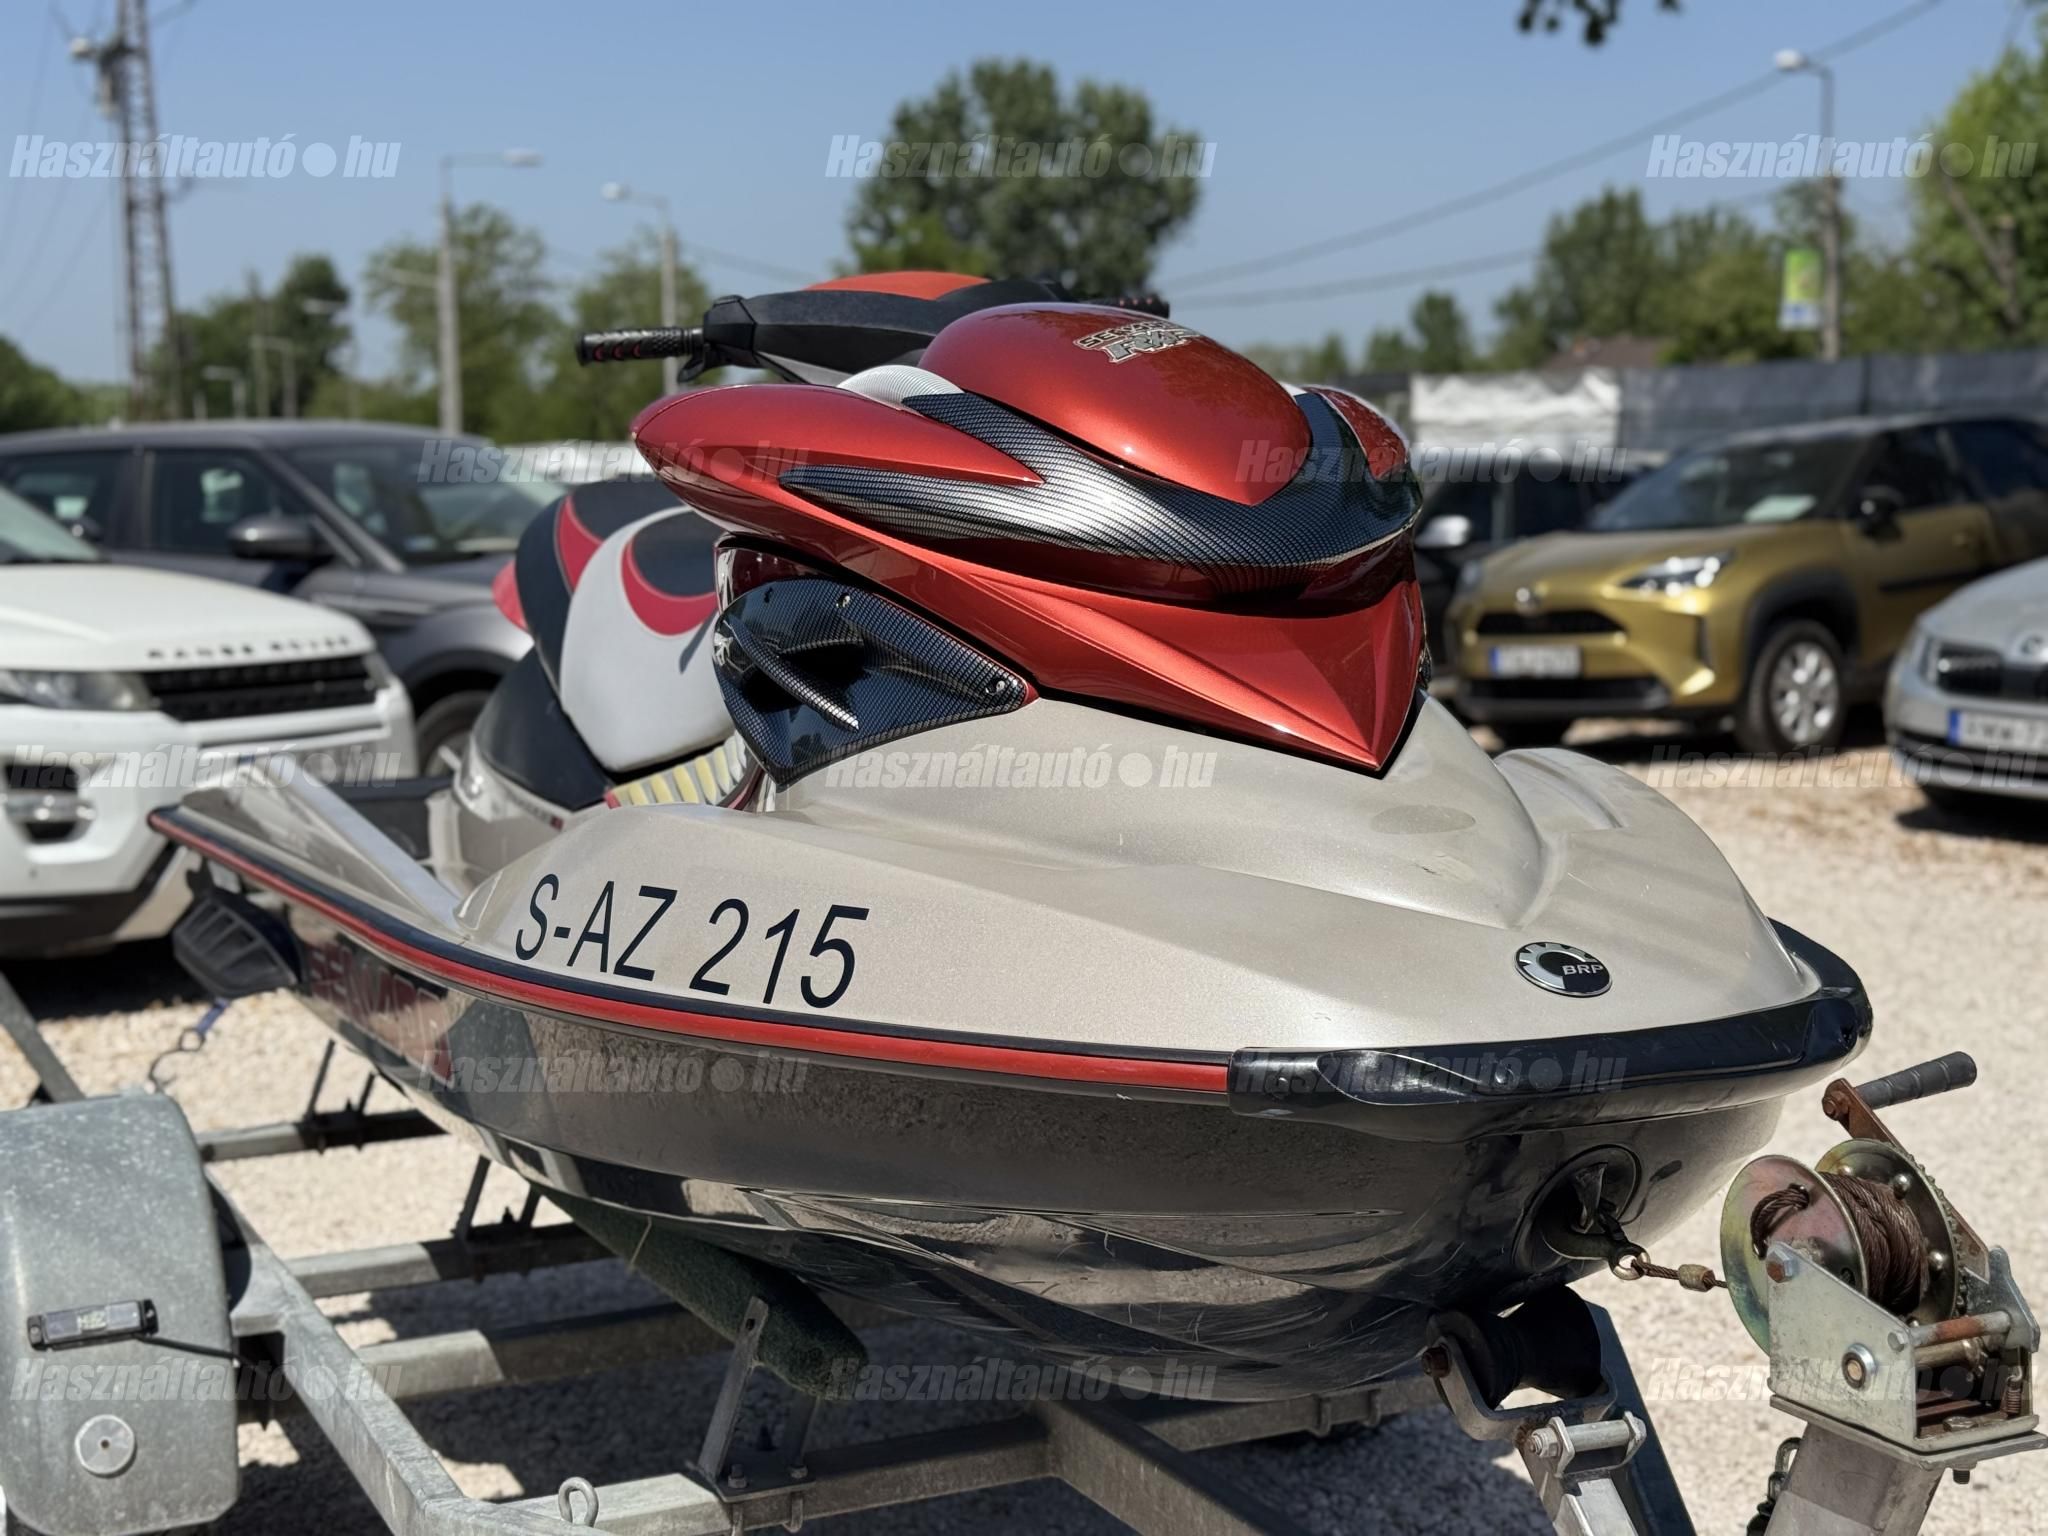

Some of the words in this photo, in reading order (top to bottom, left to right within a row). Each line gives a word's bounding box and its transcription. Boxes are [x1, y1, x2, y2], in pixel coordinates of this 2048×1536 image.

[515, 873, 678, 982] S-AZ
[688, 898, 870, 1009] 215
[1562, 964, 1604, 976] BRP
